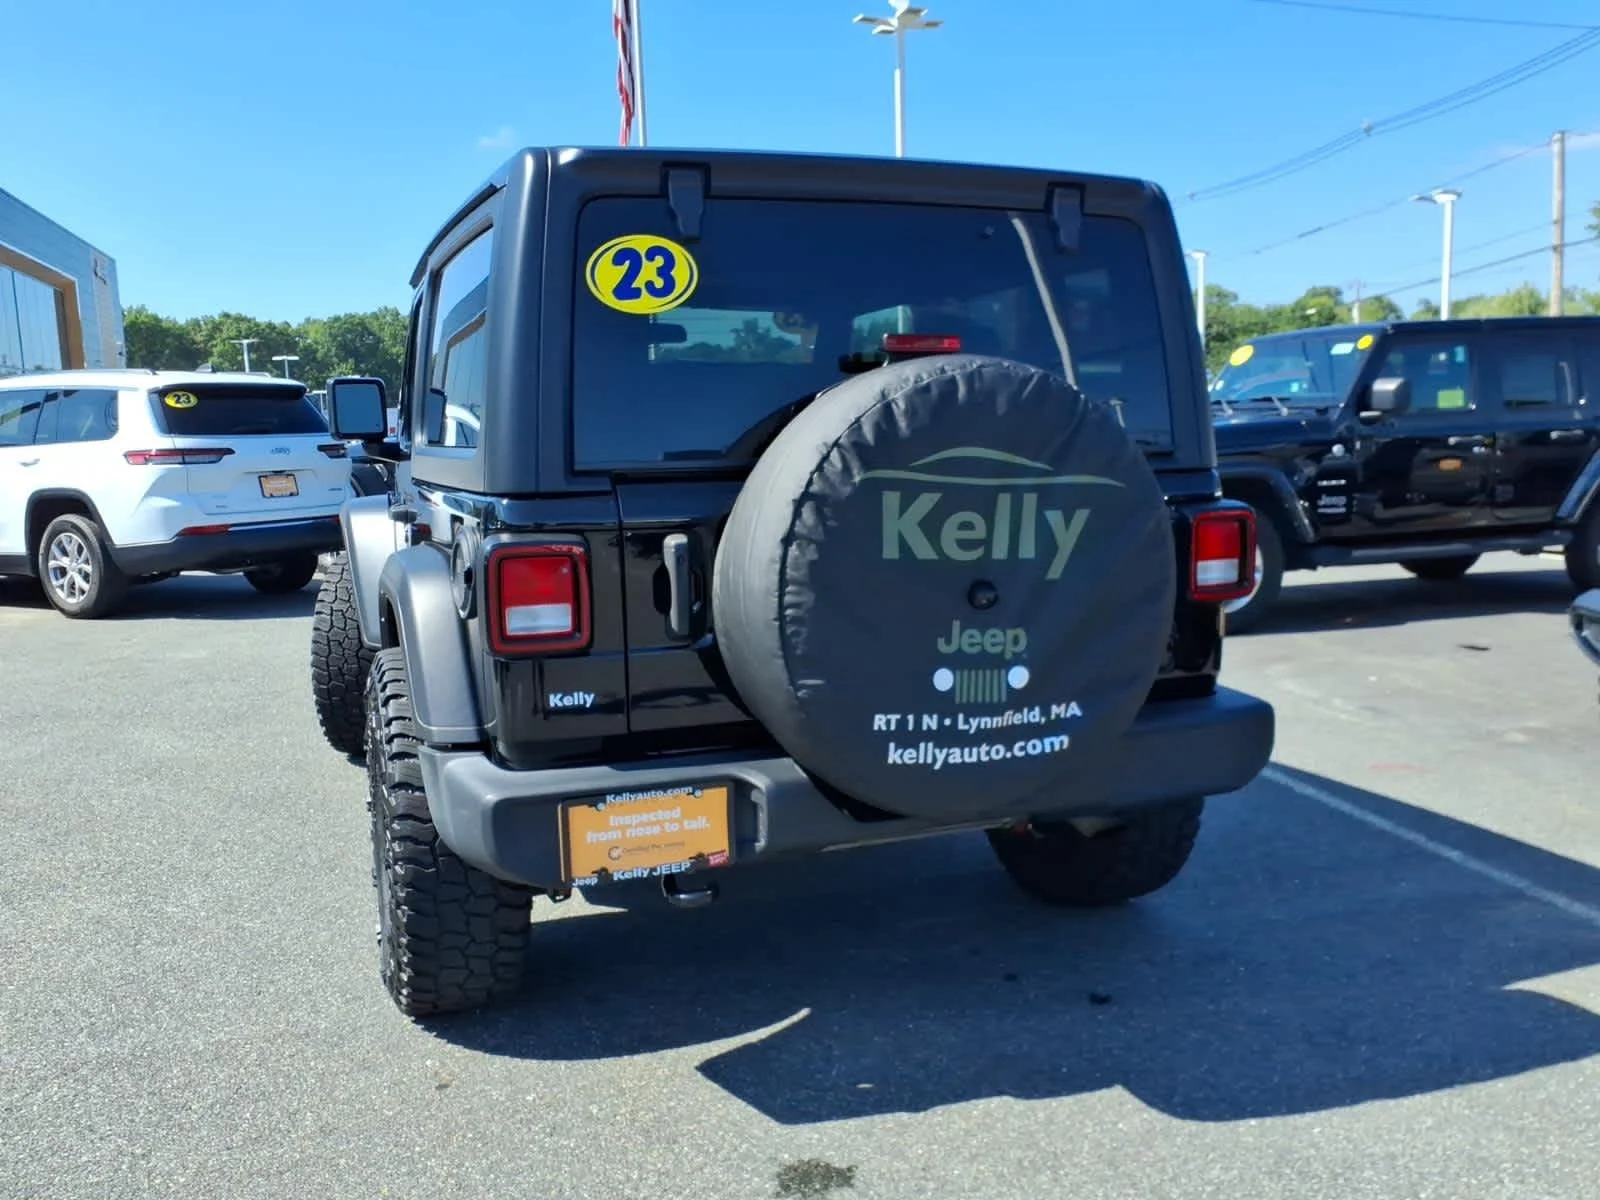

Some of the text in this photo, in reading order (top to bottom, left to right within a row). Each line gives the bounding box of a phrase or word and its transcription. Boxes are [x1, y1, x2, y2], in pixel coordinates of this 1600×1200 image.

[612, 246, 676, 301] 23
[173, 393, 192, 406] 23
[882, 491, 1091, 580] Kelly
[937, 620, 1028, 659] Jeep
[549, 691, 595, 708] Kelly
[873, 701, 1083, 734] RT 1 N Lynnfield, MA
[888, 734, 1070, 770] kellyauto.com
[606, 786, 694, 803] Kellyauto.com
[609, 807, 682, 826] Inspected
[586, 830, 622, 844] from
[626, 825, 661, 838] nose
[664, 821, 681, 832] to
[613, 861, 693, 881] Kelly JEEP
[572, 876, 598, 888] Jeep
